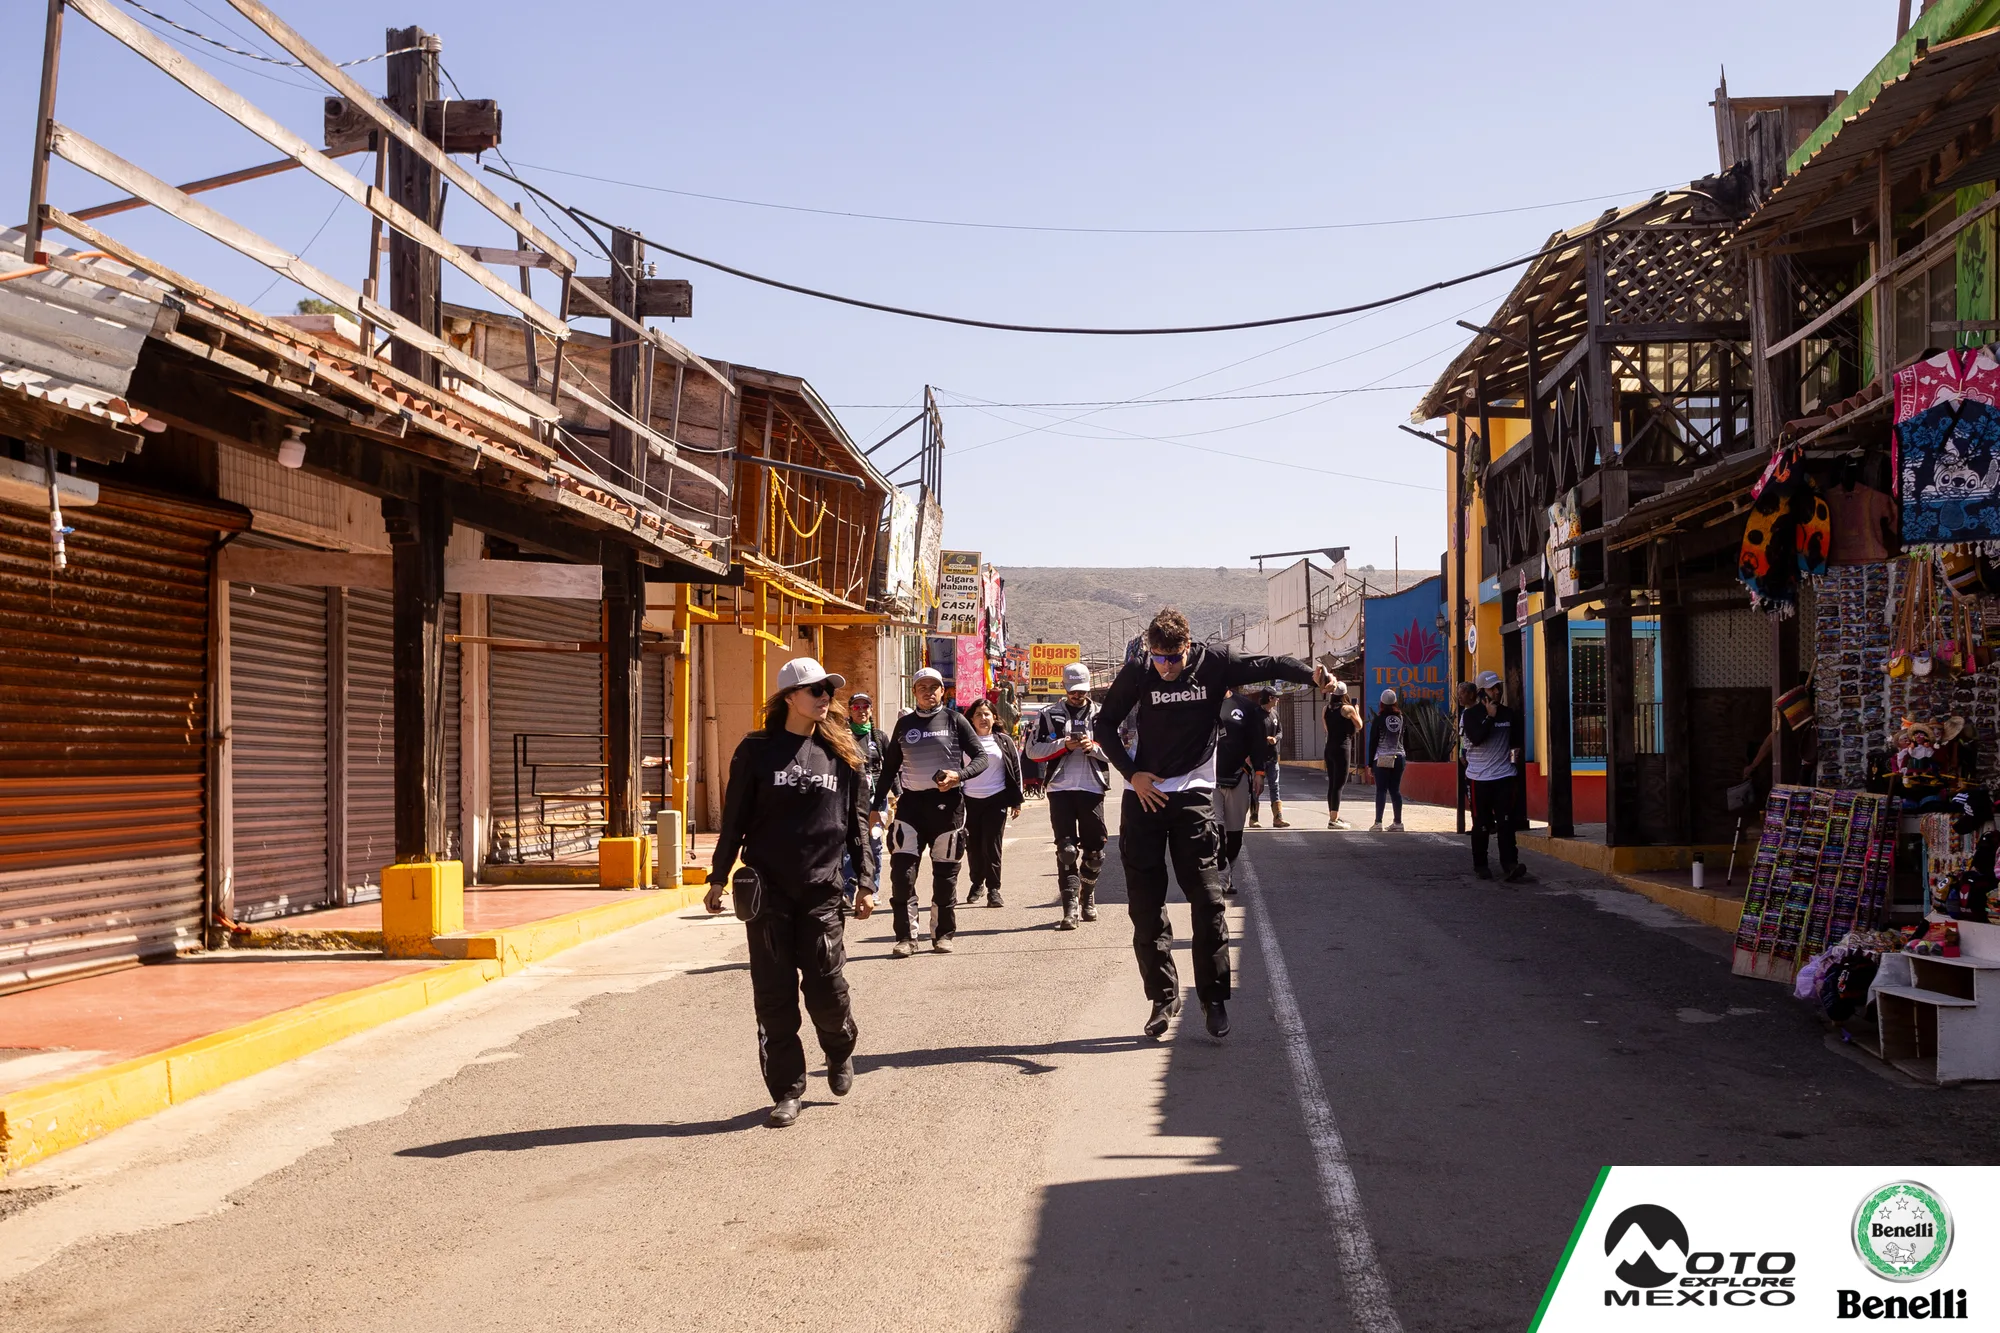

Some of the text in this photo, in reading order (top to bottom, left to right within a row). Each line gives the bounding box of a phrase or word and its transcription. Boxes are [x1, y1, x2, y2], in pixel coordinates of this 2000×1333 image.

[945, 575, 975, 584] Cigars
[940, 583, 978, 591] Habanos
[941, 601, 975, 610] CASH
[940, 613, 974, 622] BACK
[1032, 645, 1077, 659] Cigars
[1033, 661, 1064, 677] Haban
[922, 729, 949, 738] Benelli
[773, 771, 838, 793] Beelli
